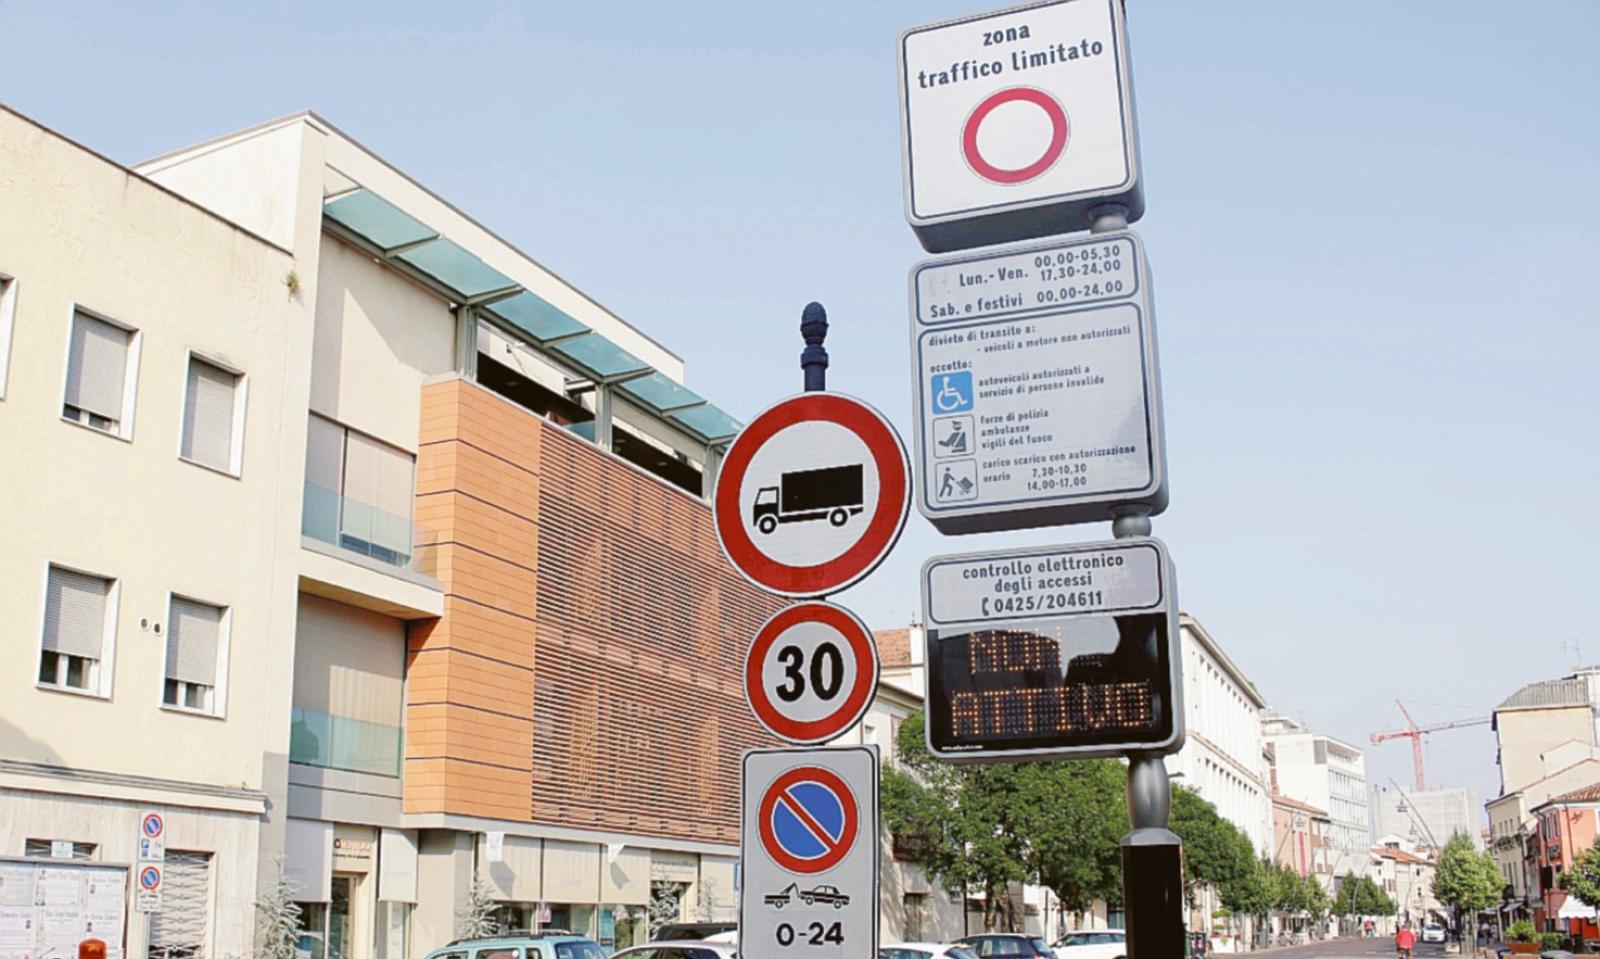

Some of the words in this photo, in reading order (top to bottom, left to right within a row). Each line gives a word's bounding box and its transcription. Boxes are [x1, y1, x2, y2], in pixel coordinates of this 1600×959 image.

[983, 24, 1030, 46] zona
[918, 58, 1003, 89] traffico
[1012, 40, 1103, 71] limitato
[998, 267, 1029, 281] Ven.
[930, 300, 960, 318] Sab.
[965, 303, 972, 312] e
[977, 293, 1023, 311] festivi
[929, 333, 964, 346] divieto
[967, 331, 977, 341] di
[980, 326, 1022, 340] transito
[1025, 325, 1036, 334] a:
[984, 341, 1014, 353] veicoli
[1026, 336, 1058, 347] motore
[1061, 334, 1078, 343] non
[1081, 326, 1131, 340] autorizzati
[930, 360, 972, 373] eccetto:
[978, 371, 1029, 386] autoveicoli
[1032, 365, 1082, 380] autorizzati
[979, 385, 1014, 399] servizio
[1016, 384, 1025, 393] di
[1028, 381, 1063, 395] persone
[1066, 375, 1105, 388] invalide
[980, 414, 1003, 424] forze
[1006, 412, 1015, 421] di
[1018, 408, 1049, 422] polizia
[981, 425, 1030, 437] ambulanze
[981, 437, 1006, 450] vigili
[1009, 435, 1024, 446] del
[1027, 434, 1053, 444] fuoco
[983, 457, 1011, 469] carico
[1014, 454, 1047, 466] scarico
[1050, 453, 1066, 462] con
[1069, 445, 1136, 460] autorizzazione
[983, 472, 1011, 483] orario
[963, 560, 1032, 579] controllo
[1038, 554, 1124, 573] elettronico
[995, 574, 1032, 593] degli
[1038, 572, 1092, 589] accessi
[994, 590, 1103, 613] 0425/204611
[776, 642, 844, 702] 30
[952, 681, 1146, 736] ATTIVO
[776, 922, 844, 947] 0-24
